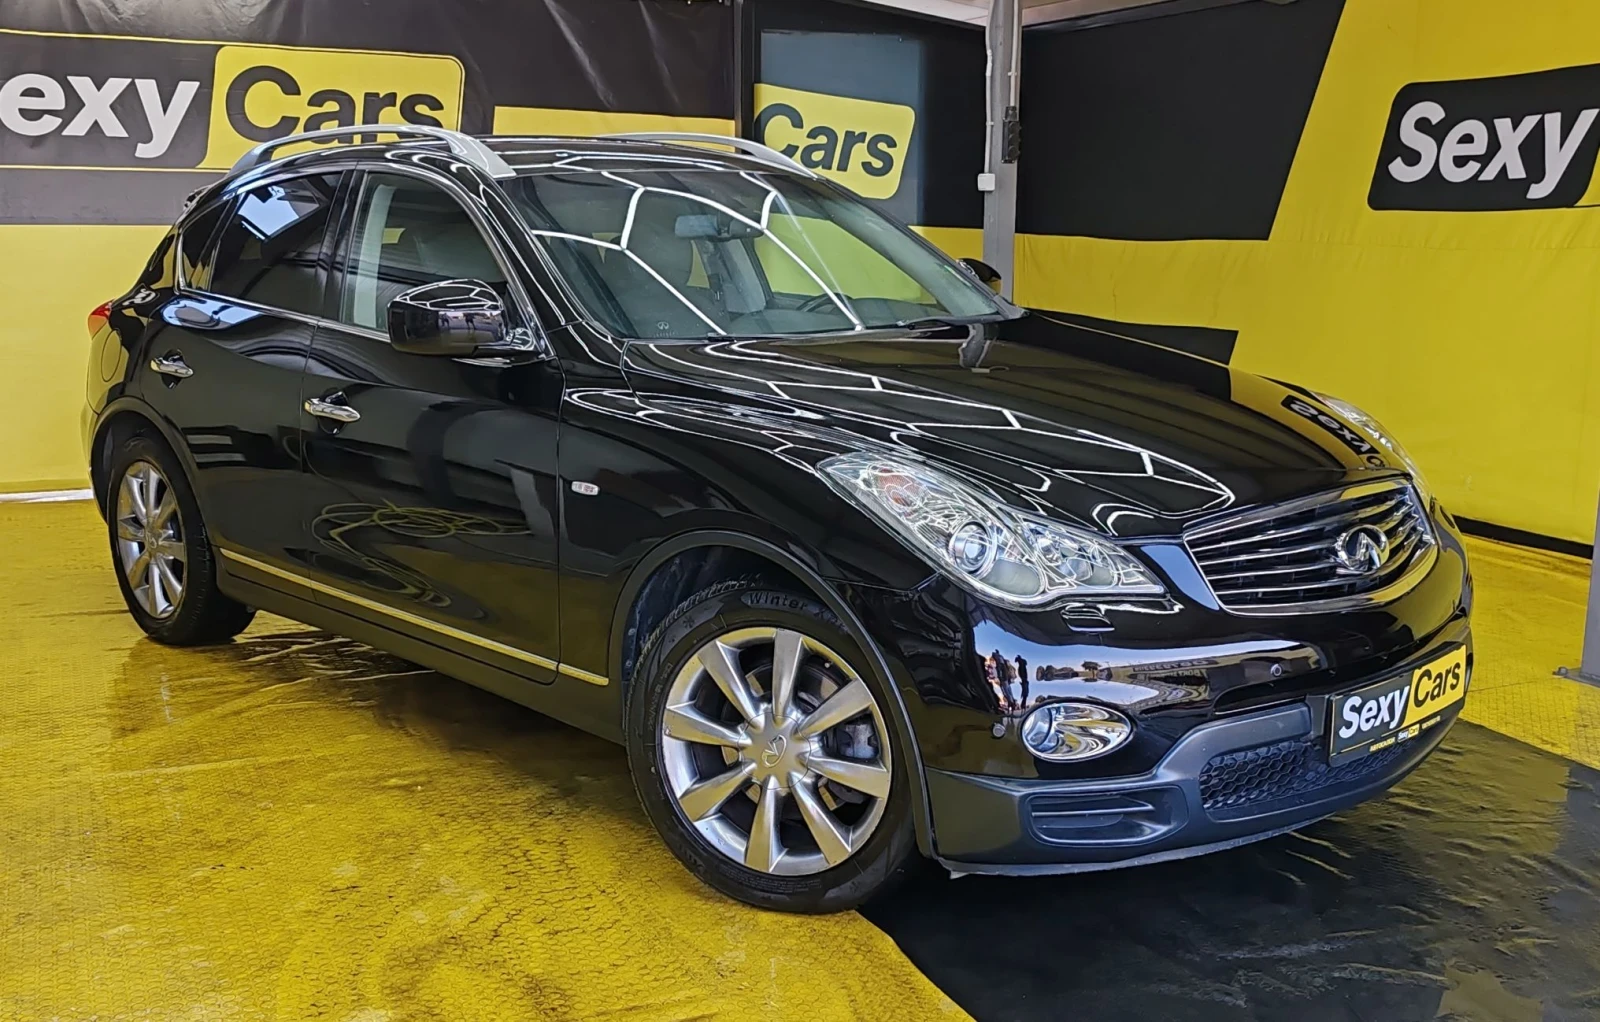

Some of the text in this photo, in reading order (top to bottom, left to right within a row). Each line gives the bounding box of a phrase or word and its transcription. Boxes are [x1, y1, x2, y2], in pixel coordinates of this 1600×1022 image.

[226, 65, 445, 145] Cars
[754, 103, 898, 177] Cars
[1387, 101, 1600, 200] Sexy
[1339, 662, 1461, 739] Sexy Cars
